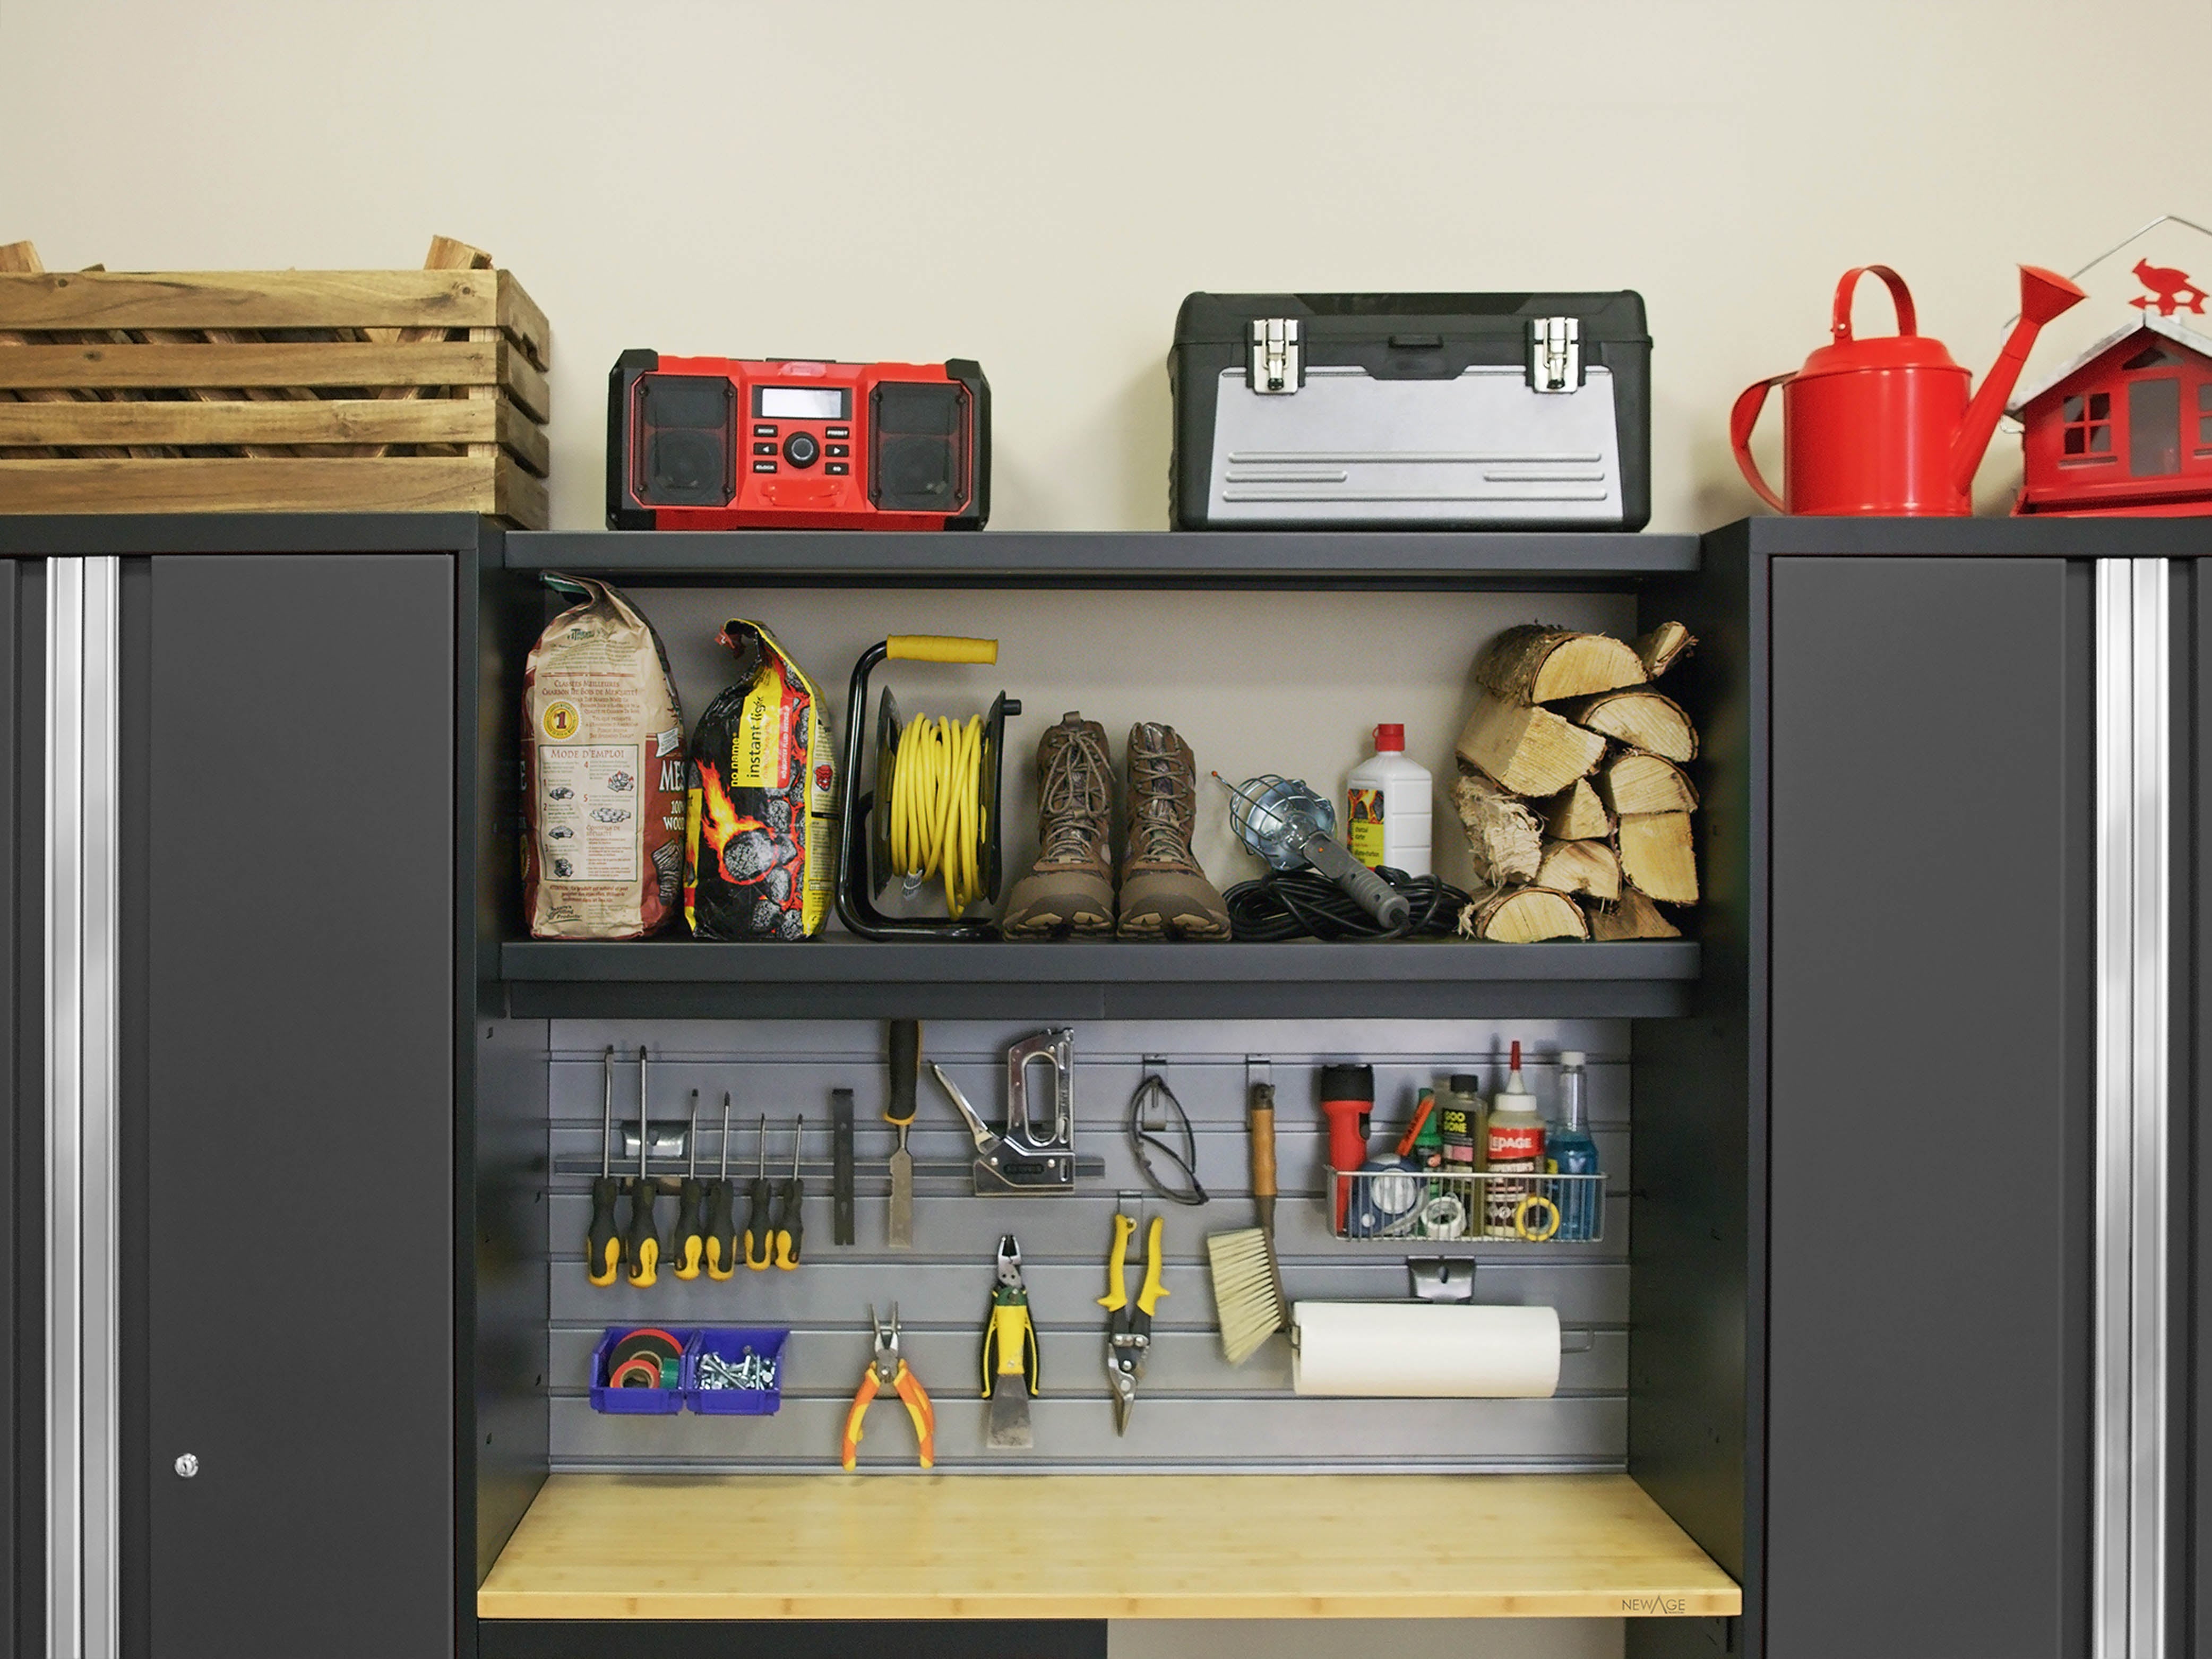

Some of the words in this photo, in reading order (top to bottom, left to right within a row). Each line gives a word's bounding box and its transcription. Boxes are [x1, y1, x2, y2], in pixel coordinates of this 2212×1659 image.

[554, 711, 566, 729] 1
[551, 749, 579, 758] MODE
[582, 749, 624, 758] D'EMPLOI
[731, 737, 740, 768] name
[746, 725, 762, 778] instant
[731, 769, 739, 787] no
[1444, 1111, 1465, 1122] GOO
[1444, 1121, 1467, 1133] GONE
